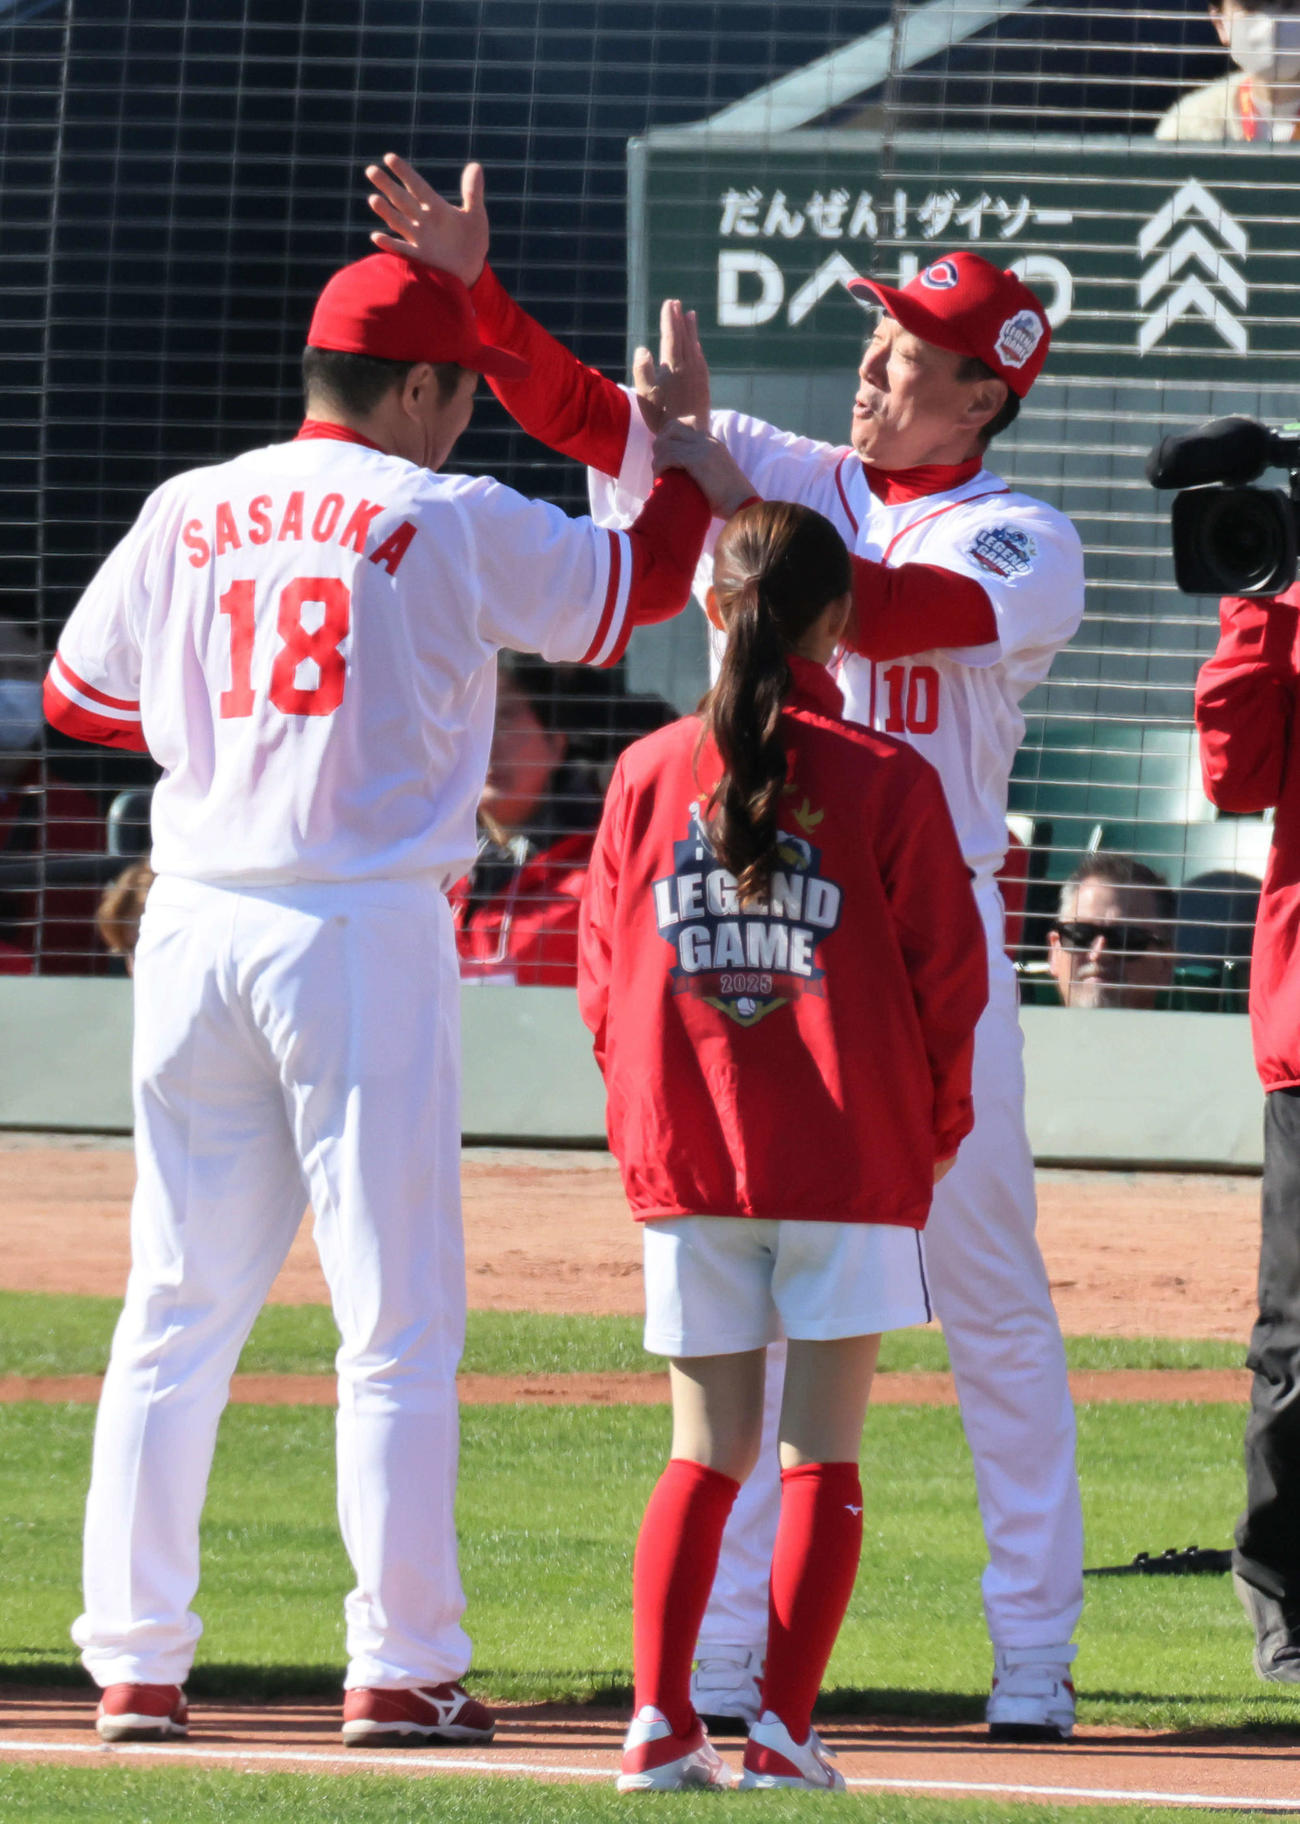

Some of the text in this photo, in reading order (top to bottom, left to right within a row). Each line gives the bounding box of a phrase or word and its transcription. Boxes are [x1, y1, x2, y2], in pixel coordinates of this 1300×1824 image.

[182, 490, 418, 577] SASAOKA
[976, 544, 1016, 575] GAME
[977, 530, 1030, 572] LEGEND
[219, 576, 351, 719] 18
[883, 664, 940, 735] 10
[678, 921, 814, 977] GAME
[720, 974, 773, 994] 2025
